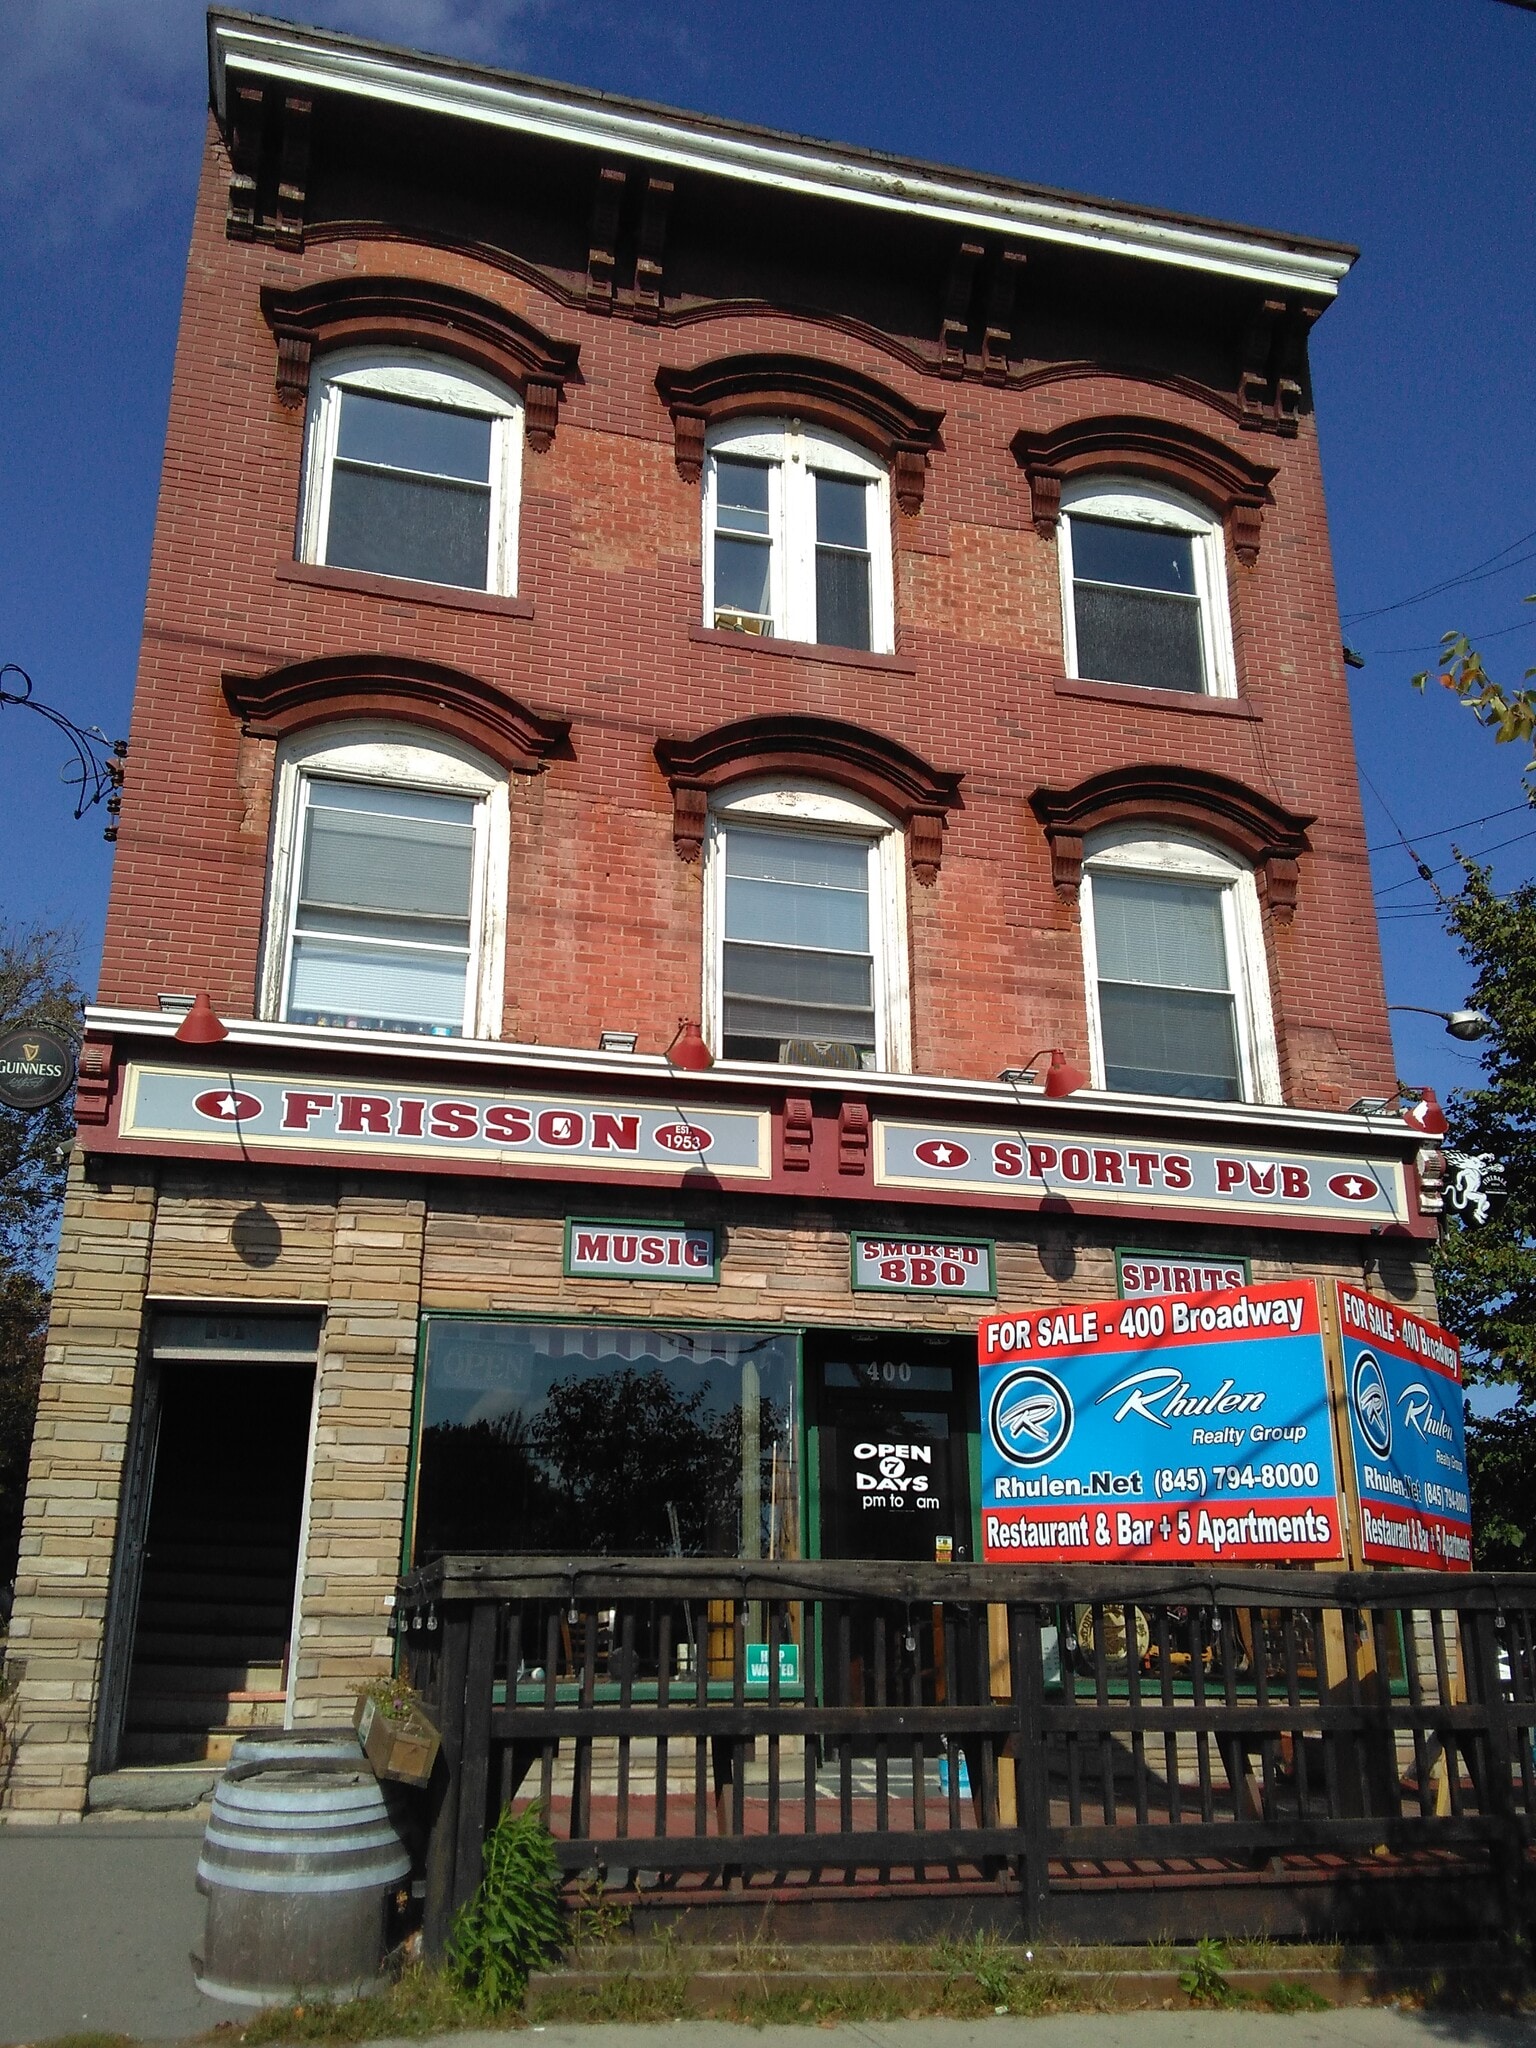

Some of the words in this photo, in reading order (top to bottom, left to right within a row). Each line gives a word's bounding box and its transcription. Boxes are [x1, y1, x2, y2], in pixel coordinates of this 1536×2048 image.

[0, 1060, 62, 1077] GUINNESS
[280, 1090, 643, 1153] FRISSON
[675, 1125, 692, 1135] EST.
[665, 1133, 701, 1150] 1953
[992, 1140, 1195, 1191] SPORTS
[1214, 1157, 1312, 1201] PUB
[575, 1232, 710, 1268] MUSIC
[863, 1241, 980, 1266] SMOKED
[878, 1257, 968, 1288] BBQ
[1122, 1262, 1244, 1294] SPIRITS
[987, 1320, 1032, 1353] FOR
[1037, 1311, 1099, 1347] SALE
[1119, 1305, 1165, 1339] 400
[1172, 1296, 1304, 1334] Broadway
[1342, 1291, 1369, 1331] FOR
[1367, 1302, 1395, 1342] SALE
[1402, 1318, 1420, 1353] 400
[866, 1361, 912, 1382] 400
[1095, 1366, 1267, 1429] Rhulen
[1397, 1383, 1454, 1442] Rhulen
[1192, 1426, 1245, 1446] Realty
[1250, 1424, 1308, 1442] Group
[853, 1443, 931, 1464] OPEN
[884, 1460, 899, 1475] 7
[856, 1472, 929, 1492] DAYS
[994, 1471, 1143, 1499] Rhulen.Net
[1154, 1468, 1207, 1498] (845)
[1212, 1462, 1319, 1490] 794-8000
[862, 1495, 887, 1510] pm
[889, 1493, 904, 1507] to
[916, 1497, 940, 1509] am
[1424, 1481, 1445, 1512] (845)
[986, 1514, 1089, 1549] Restaurant
[1094, 1512, 1112, 1546] &
[1116, 1511, 1153, 1546] Bar
[1177, 1511, 1192, 1546] 5
[1197, 1508, 1331, 1553] Apartments
[1363, 1508, 1411, 1550] Restaurant
[751, 1663, 794, 1677] WAED
[760, 1650, 785, 1663] HP
